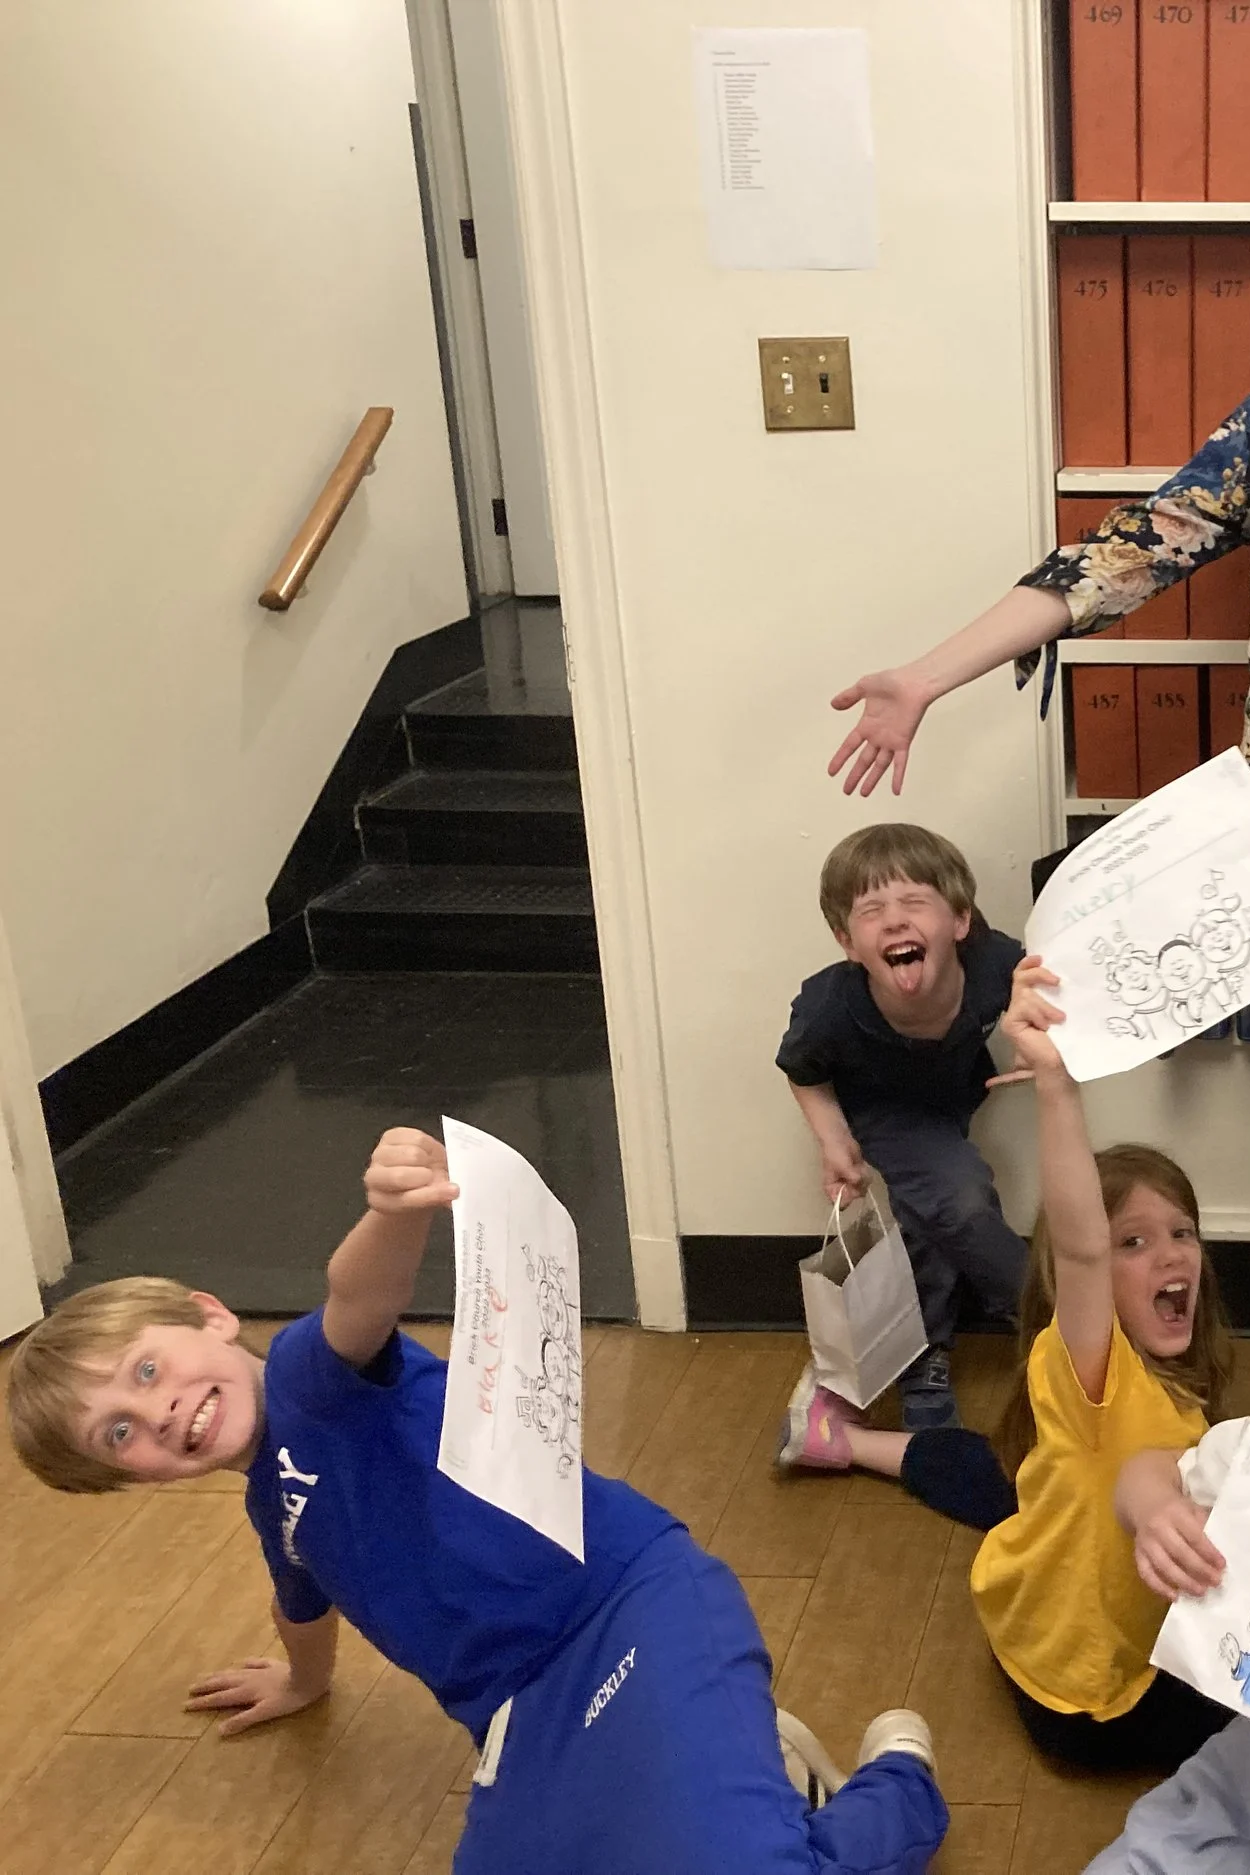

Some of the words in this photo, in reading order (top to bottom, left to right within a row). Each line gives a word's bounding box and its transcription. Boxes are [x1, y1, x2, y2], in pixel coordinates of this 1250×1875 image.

[1084, 5, 1123, 26] 469
[1153, 5, 1193, 24] 470
[1073, 279, 1108, 301] 475
[1141, 280, 1178, 297] 476
[1210, 279, 1243, 298] 477
[1088, 694, 1120, 710] 487
[1151, 693, 1186, 709] 488
